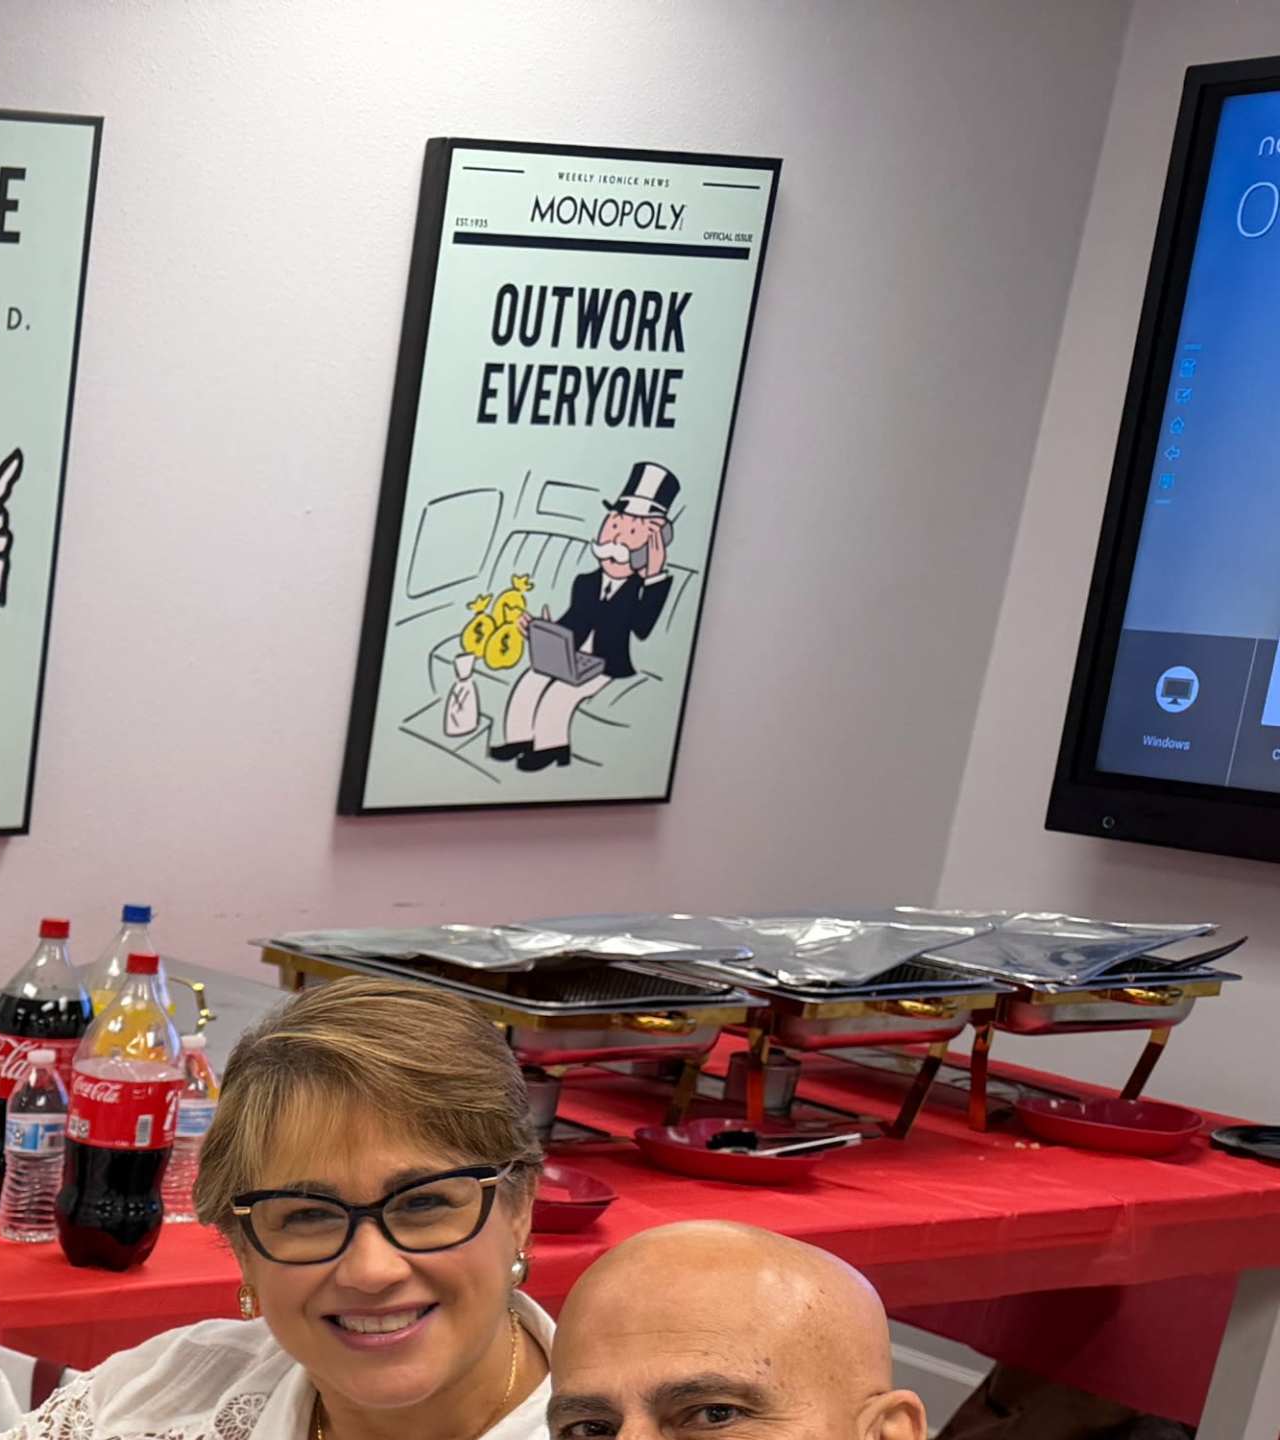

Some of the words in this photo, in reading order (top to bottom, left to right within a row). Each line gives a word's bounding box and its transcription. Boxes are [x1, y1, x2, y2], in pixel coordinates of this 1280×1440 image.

[558, 171, 595, 183] WEEKLY
[643, 177, 670, 188] NEWS
[530, 195, 684, 232] MONOPOLY
[703, 231, 732, 242] OFFICIAL
[734, 232, 753, 243] ISSUE
[491, 283, 694, 354] OUTWORK
[477, 362, 685, 430] EVERYONE
